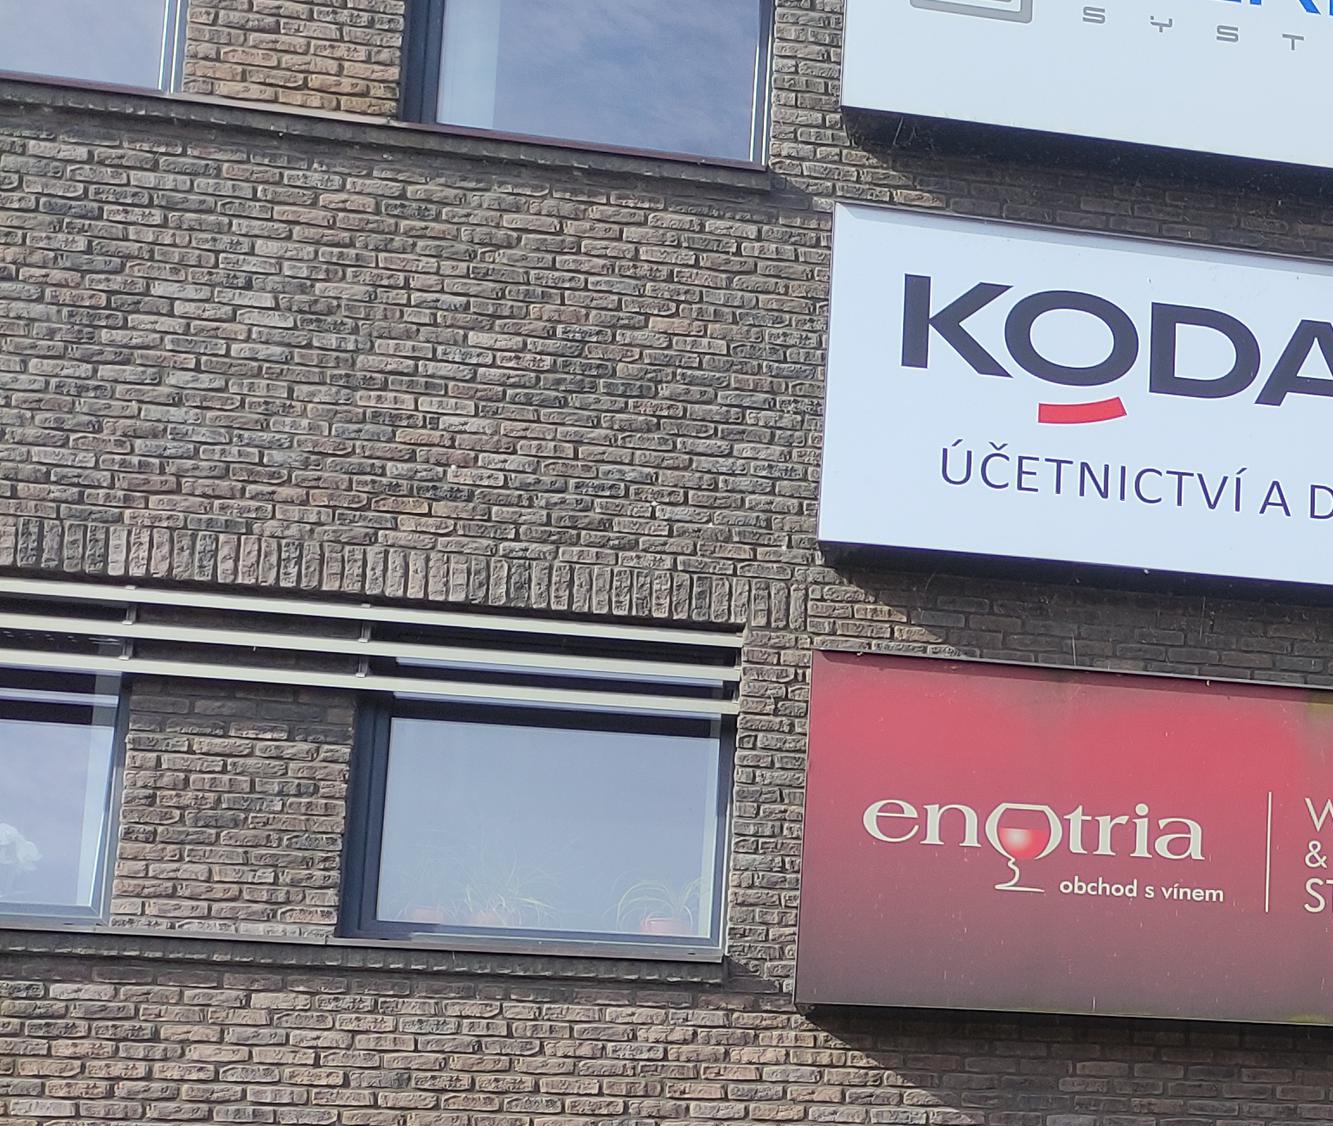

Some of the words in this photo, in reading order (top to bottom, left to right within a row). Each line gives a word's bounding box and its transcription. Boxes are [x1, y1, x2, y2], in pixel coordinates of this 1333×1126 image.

[940, 439, 1246, 513] ÚČETNICTVÍ
[1259, 480, 1292, 518] A
[862, 799, 1205, 890] enotria
[1304, 842, 1329, 869] &
[1059, 876, 1139, 902] obchod
[1145, 885, 1155, 900] s
[1162, 880, 1224, 904] vínem
